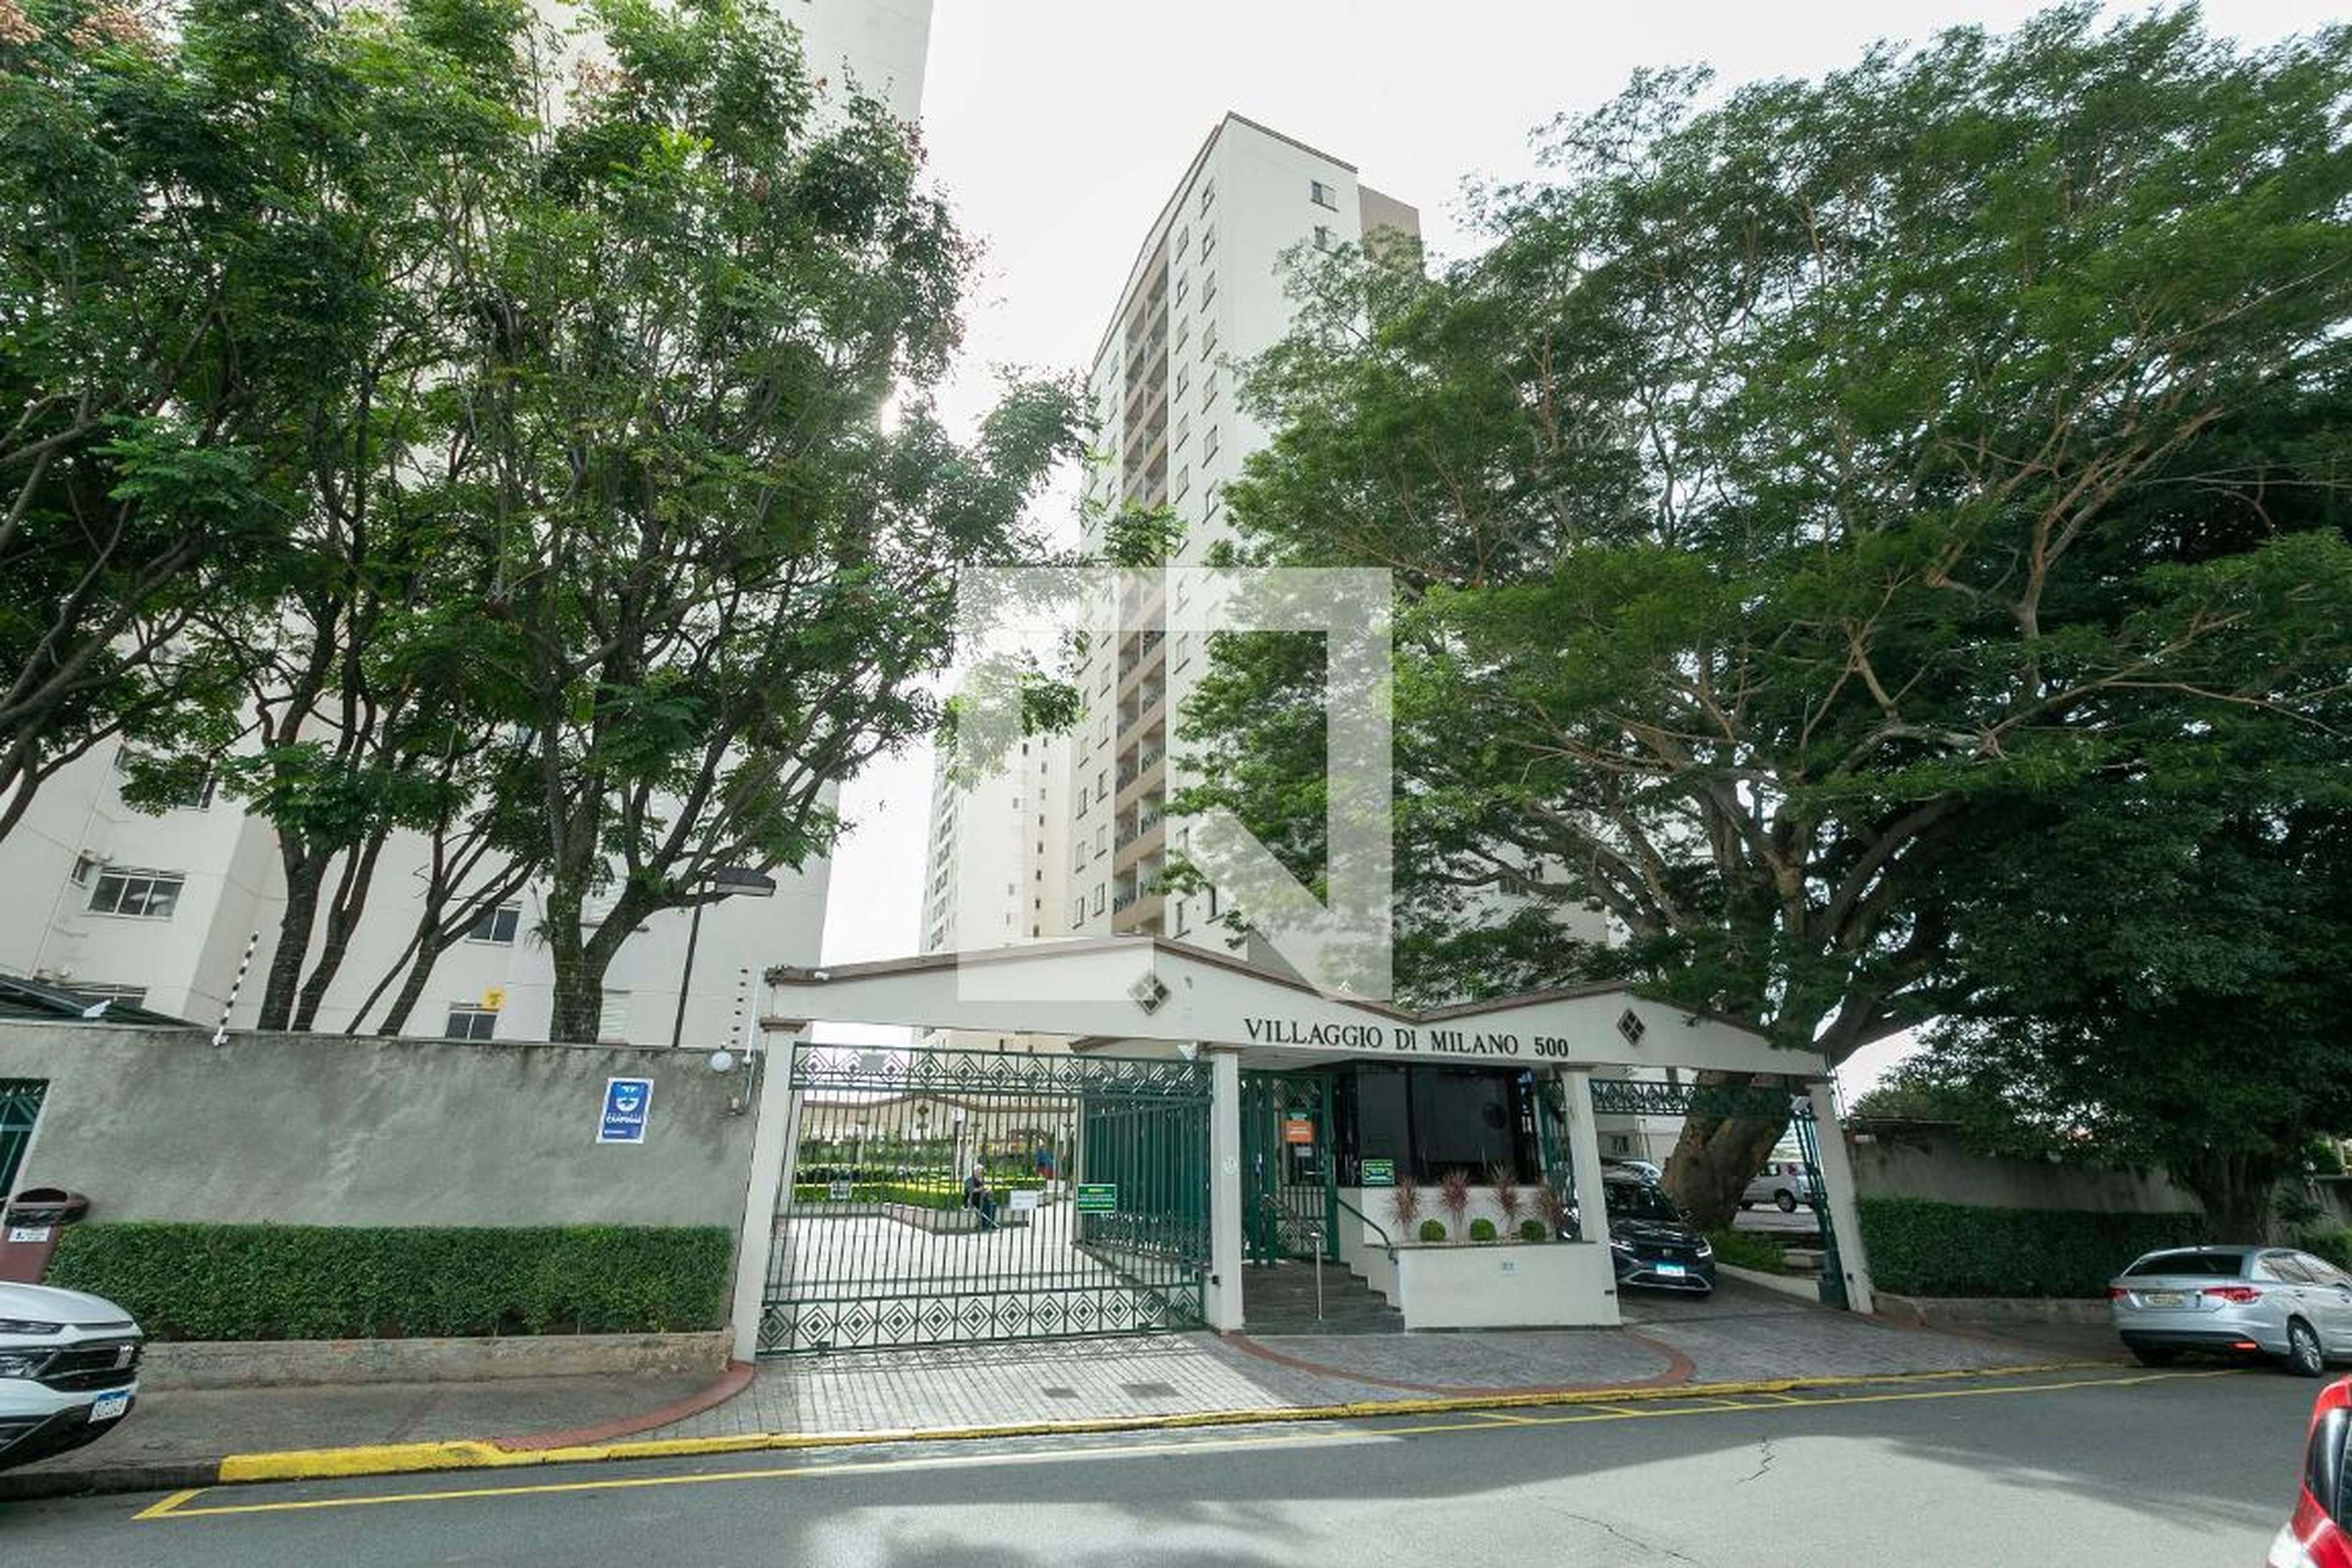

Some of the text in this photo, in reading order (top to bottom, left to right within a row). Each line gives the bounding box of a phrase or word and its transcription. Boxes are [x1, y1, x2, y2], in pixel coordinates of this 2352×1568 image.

[1243, 1018, 1569, 1057] VILLAGGIO DI MILANO 500
